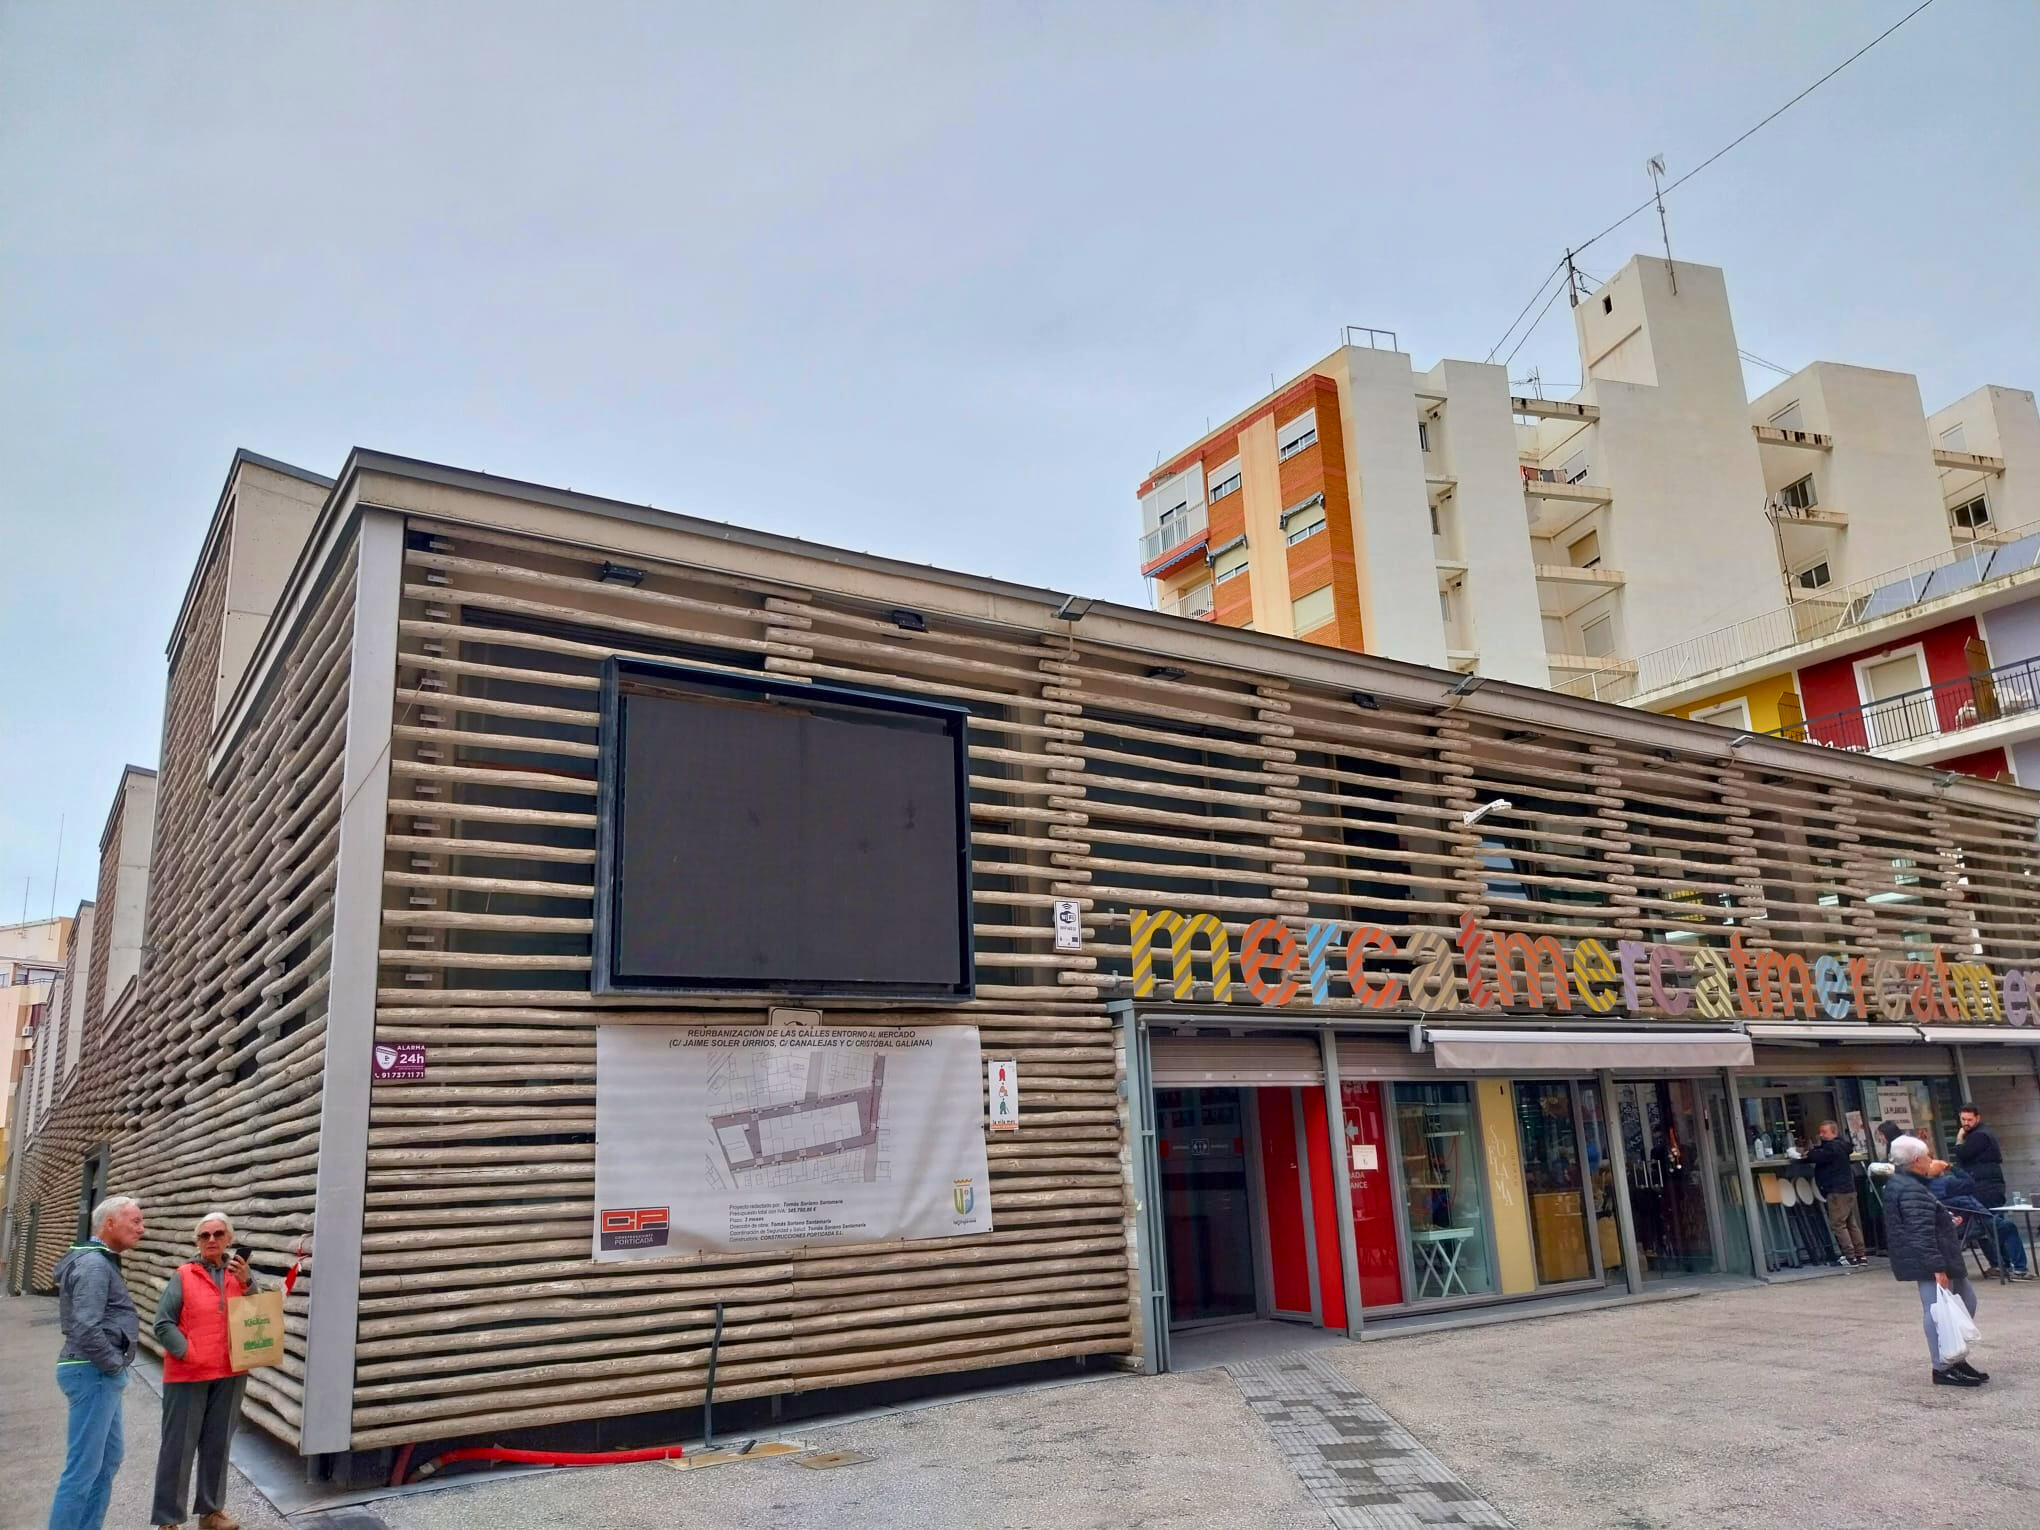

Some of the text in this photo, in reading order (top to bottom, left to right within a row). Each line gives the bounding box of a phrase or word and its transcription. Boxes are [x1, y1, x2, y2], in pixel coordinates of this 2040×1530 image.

[687, 1029, 765, 1037] REURBANIZACIÓN
[798, 1030, 830, 1038] CALLES
[831, 1030, 867, 1038] ENTORNO
[877, 1030, 916, 1038] MERCADO
[682, 1039, 709, 1047] JAIME
[711, 1039, 740, 1047] SOLER
[779, 1039, 788, 1047] C/
[789, 1039, 838, 1047] CANALEJAS
[846, 1039, 854, 1047] C/
[895, 1039, 933, 1048] GALIANA)
[399, 1053, 425, 1064] 24h
